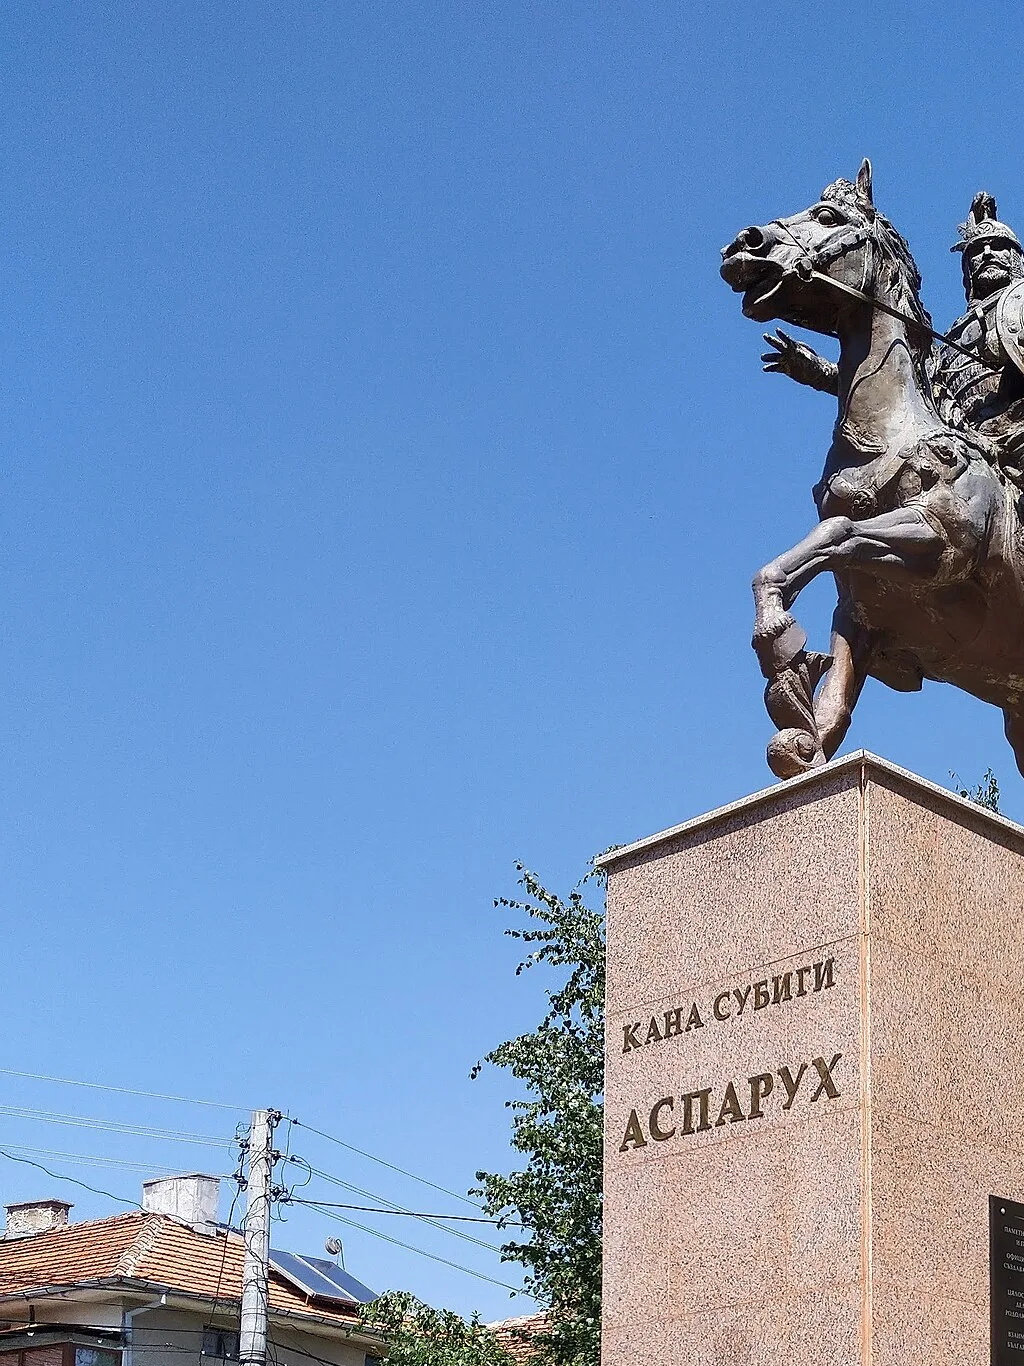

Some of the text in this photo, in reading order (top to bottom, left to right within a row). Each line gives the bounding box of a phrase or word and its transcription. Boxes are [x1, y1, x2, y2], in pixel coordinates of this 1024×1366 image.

[622, 957, 836, 1053] КАНА СУБИГИ
[619, 1053, 842, 1151] АСПАРУХ
